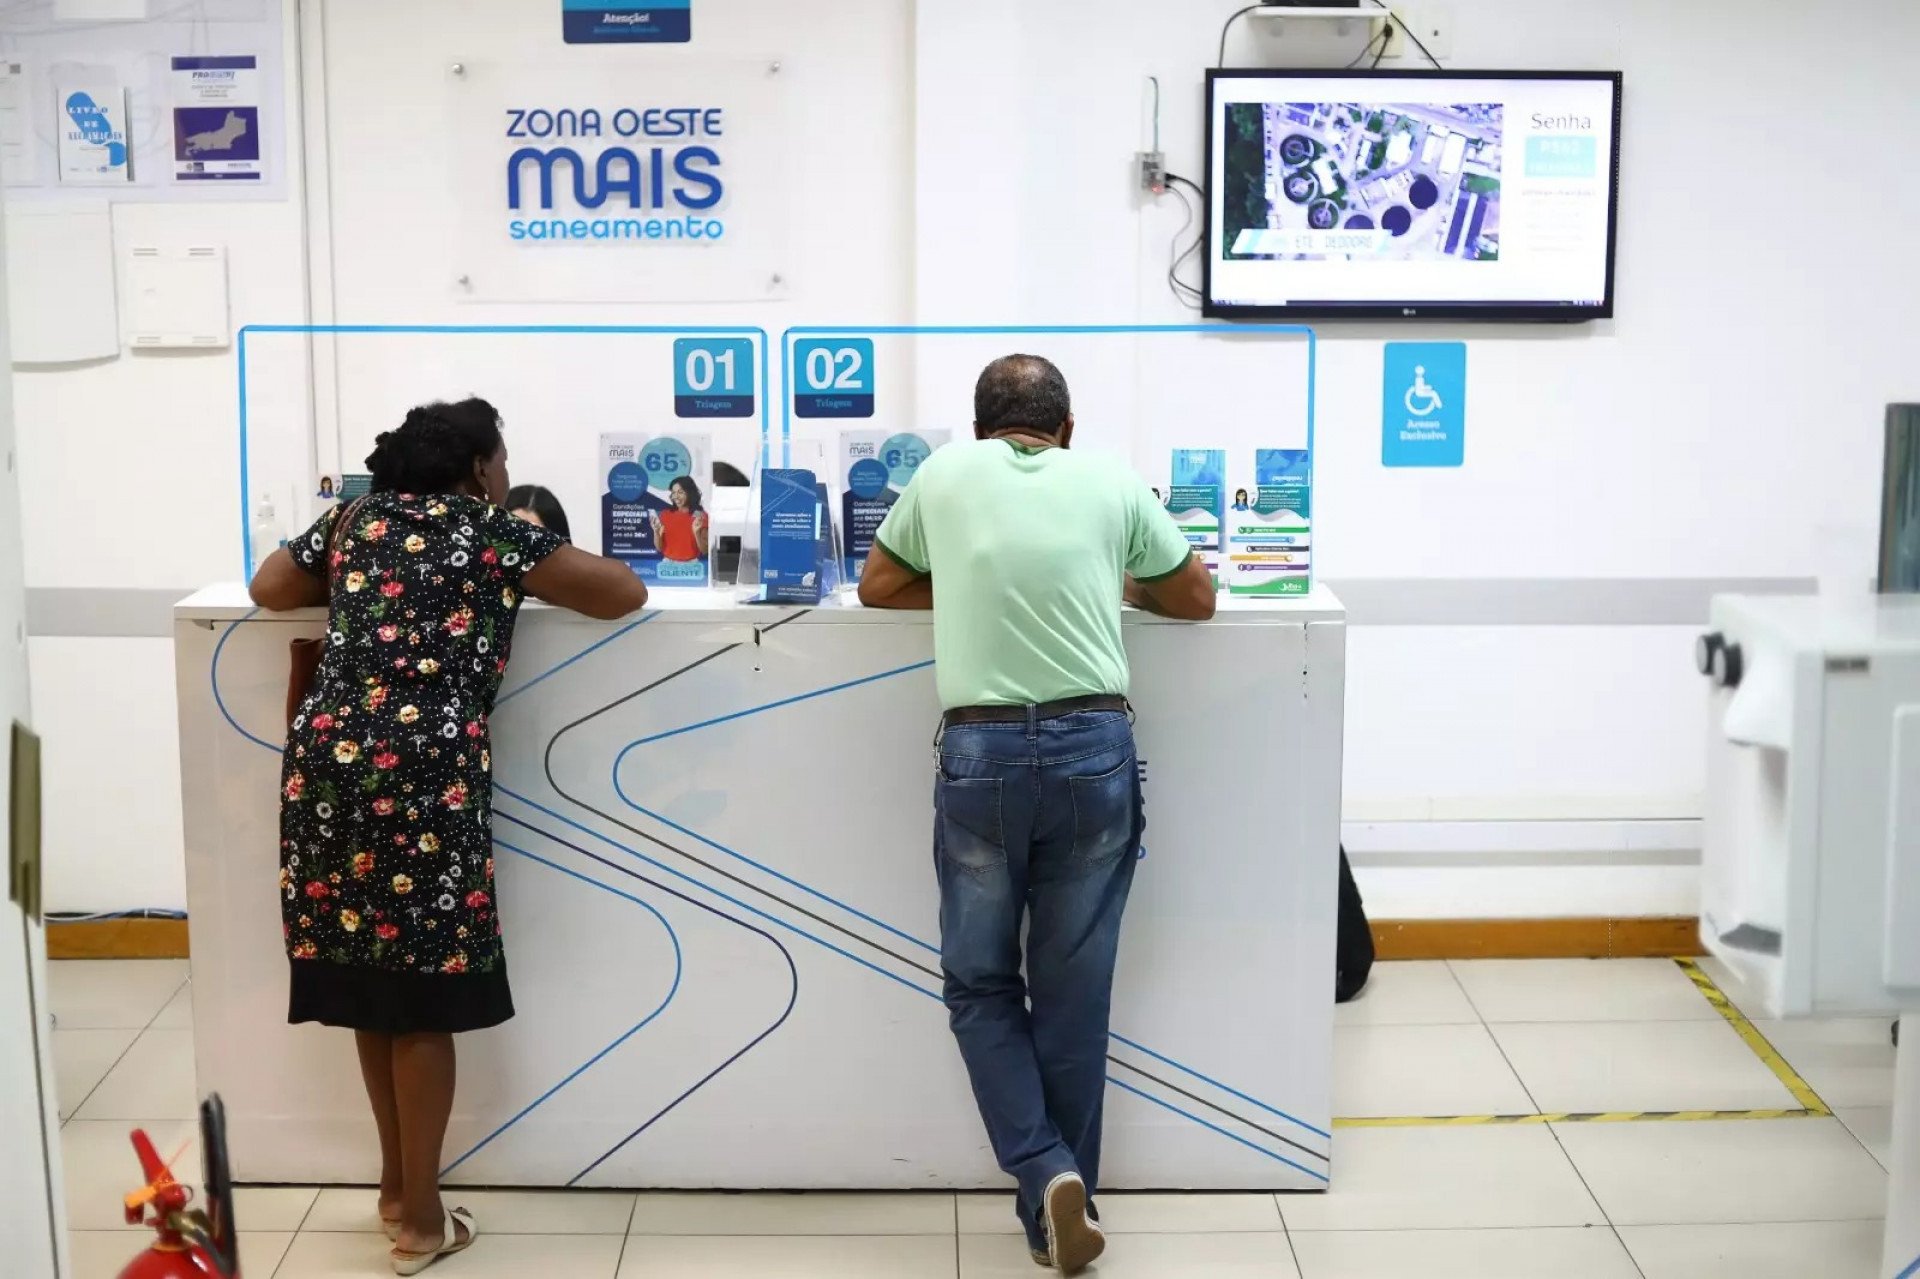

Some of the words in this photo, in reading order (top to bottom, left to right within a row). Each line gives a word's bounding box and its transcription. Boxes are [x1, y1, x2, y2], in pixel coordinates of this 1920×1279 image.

[506, 109, 602, 137] ZONA
[613, 108, 722, 136] OESTE
[1531, 112, 1592, 130] Senha
[507, 146, 723, 210] MAIS
[509, 215, 723, 240] saneamento
[685, 348, 736, 391] 01
[805, 347, 863, 389] 02
